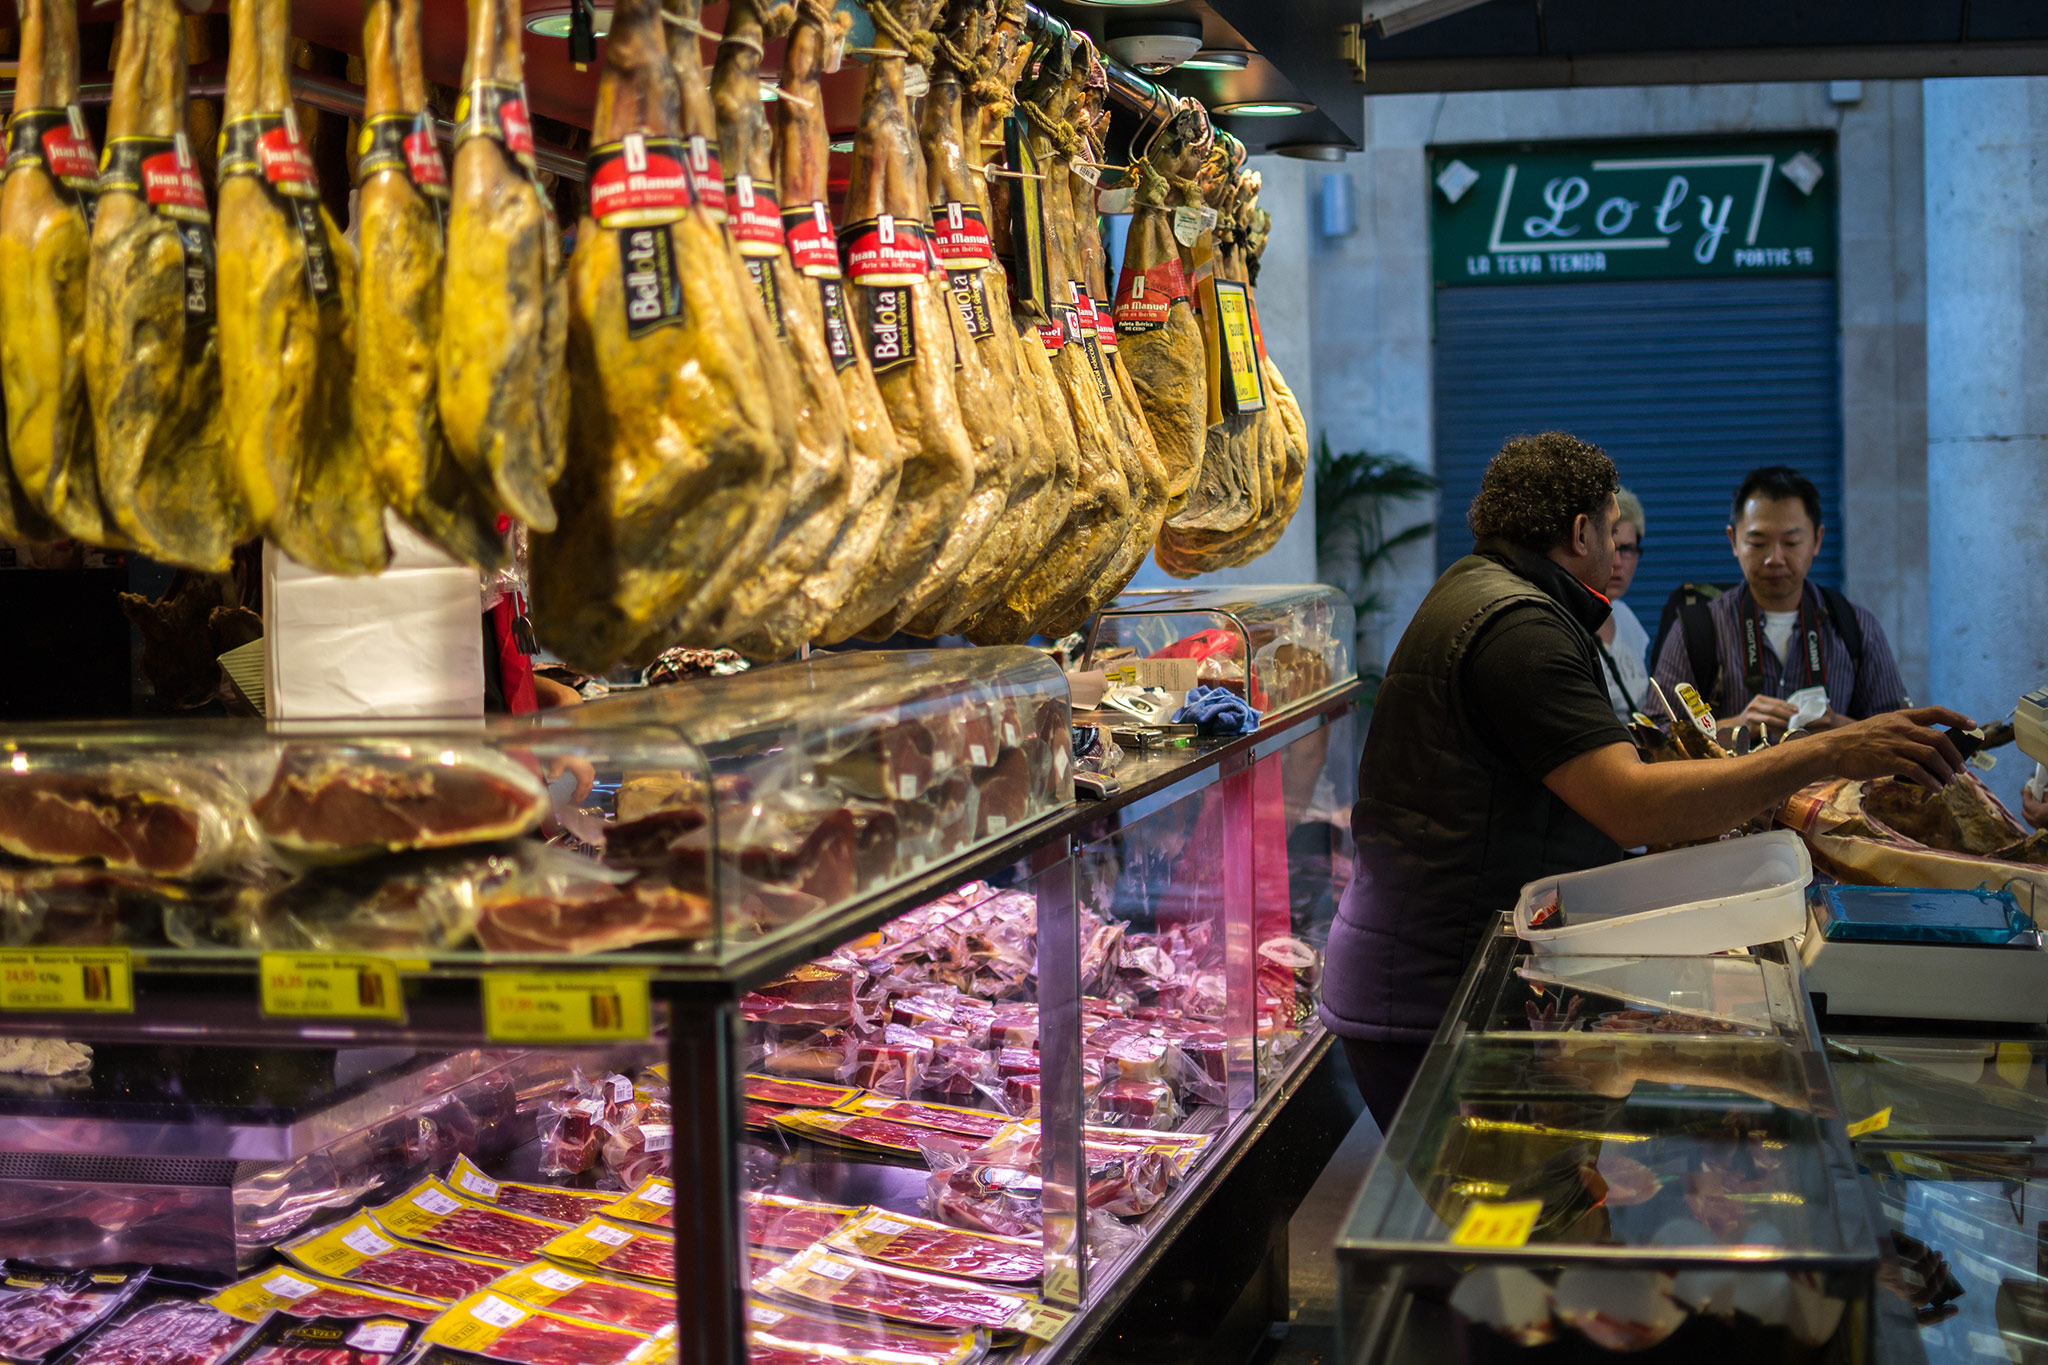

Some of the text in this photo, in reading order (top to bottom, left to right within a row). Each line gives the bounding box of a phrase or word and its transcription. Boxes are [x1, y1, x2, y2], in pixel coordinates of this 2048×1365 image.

[148, 172, 179, 187] Juan
[592, 174, 686, 203] Juan Manuel
[741, 211, 781, 229] Manuel
[1524, 175, 1734, 264] Loly
[793, 239, 820, 254] Juan
[951, 232, 989, 245] Manuel
[850, 246, 926, 266] Juan Manuel
[961, 245, 983, 253] Ibérico
[1735, 248, 1791, 267] PORTIC
[187, 229, 206, 312] Bellta
[891, 261, 917, 269] Ibérico
[1467, 252, 1606, 275] LA TEVA TENDA
[627, 230, 661, 319] Bellota
[1131, 301, 1168, 312] Manuel
[825, 284, 847, 356] Bellota
[874, 290, 900, 358] Bellota
[1135, 320, 1154, 328] Ibérica
[1746, 619, 1757, 667] DIGITAL
[1808, 630, 1820, 671] Canon
